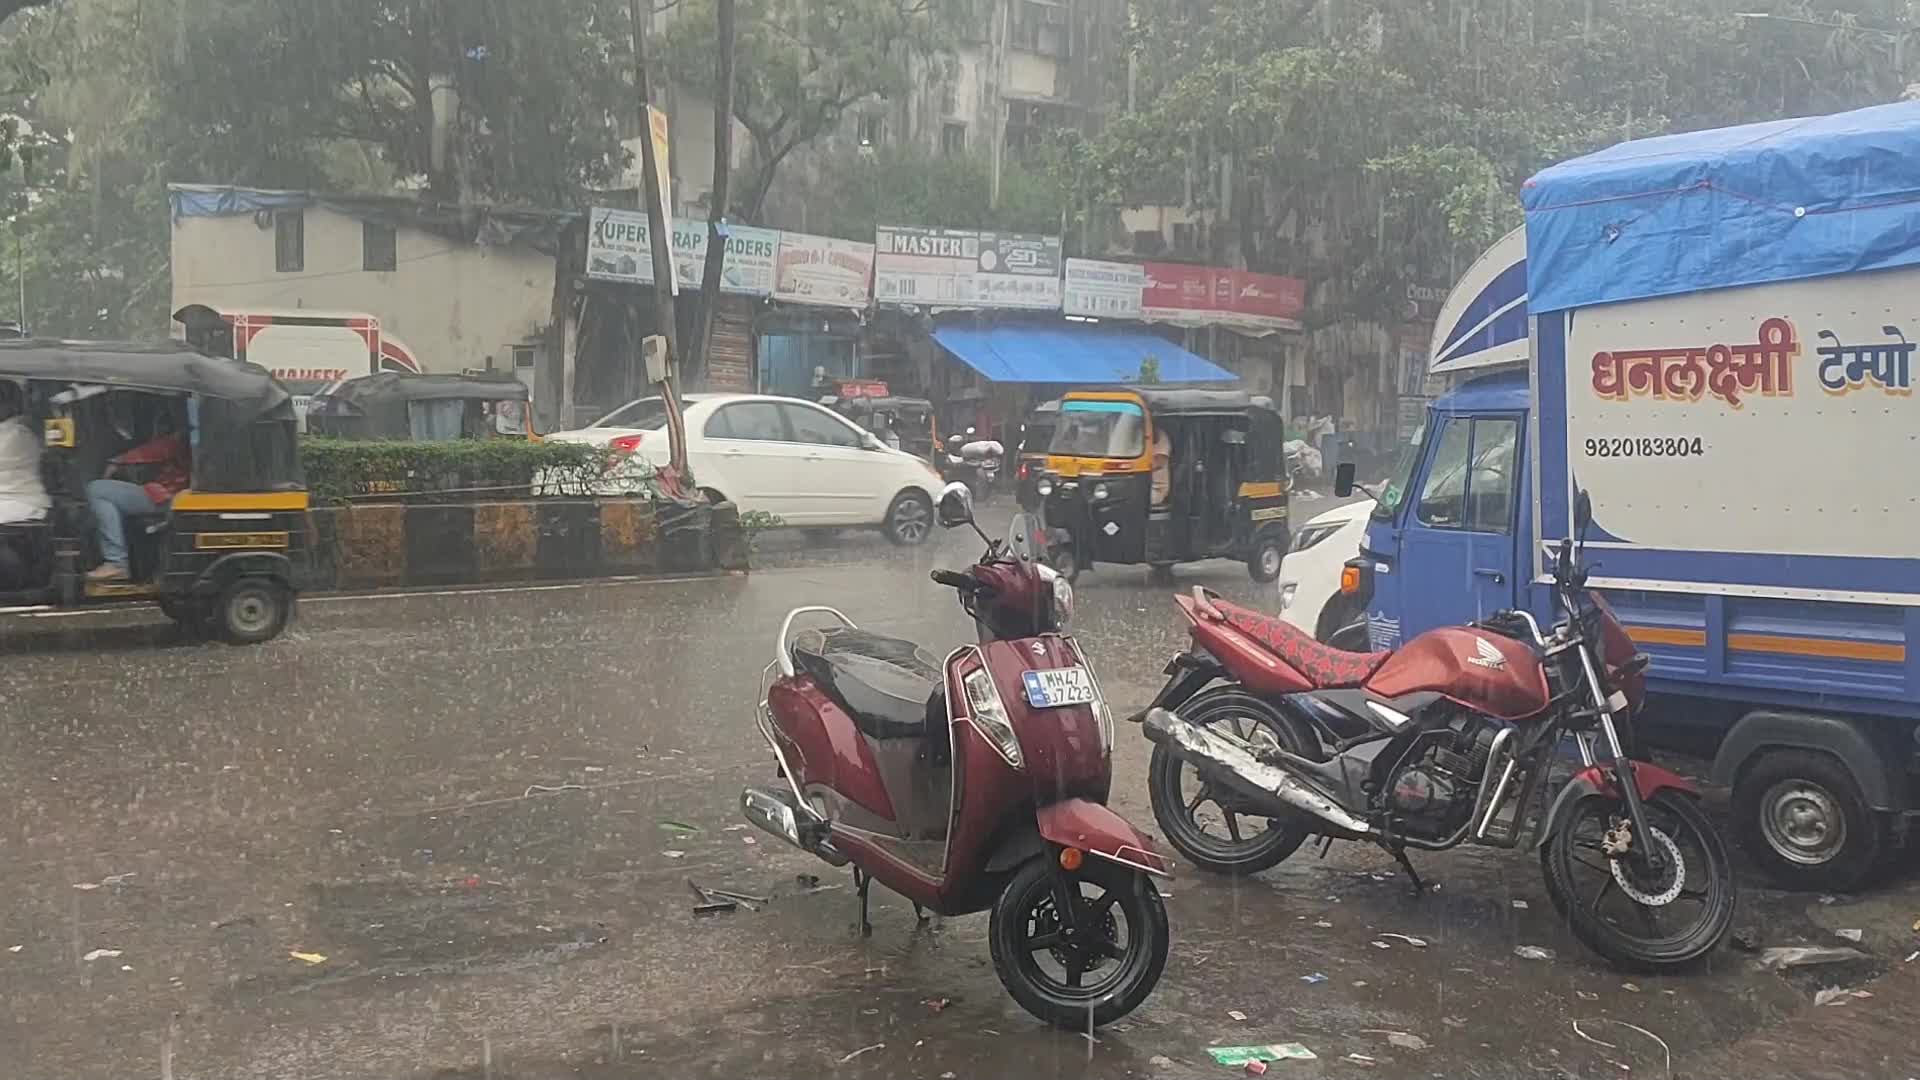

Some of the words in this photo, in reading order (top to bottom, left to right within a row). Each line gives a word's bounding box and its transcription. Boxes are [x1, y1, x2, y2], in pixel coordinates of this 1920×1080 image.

[593, 220, 647, 243] SUPER
[672, 231, 702, 249] RAP
[726, 239, 773, 257] ADERS
[894, 234, 961, 255] MASTER
[1591, 318, 1800, 409] धनलक्ष्मी
[1816, 325, 1917, 394] टेम्पो
[1584, 435, 1704, 457] 9820183804
[1044, 670, 1079, 688] MH47
